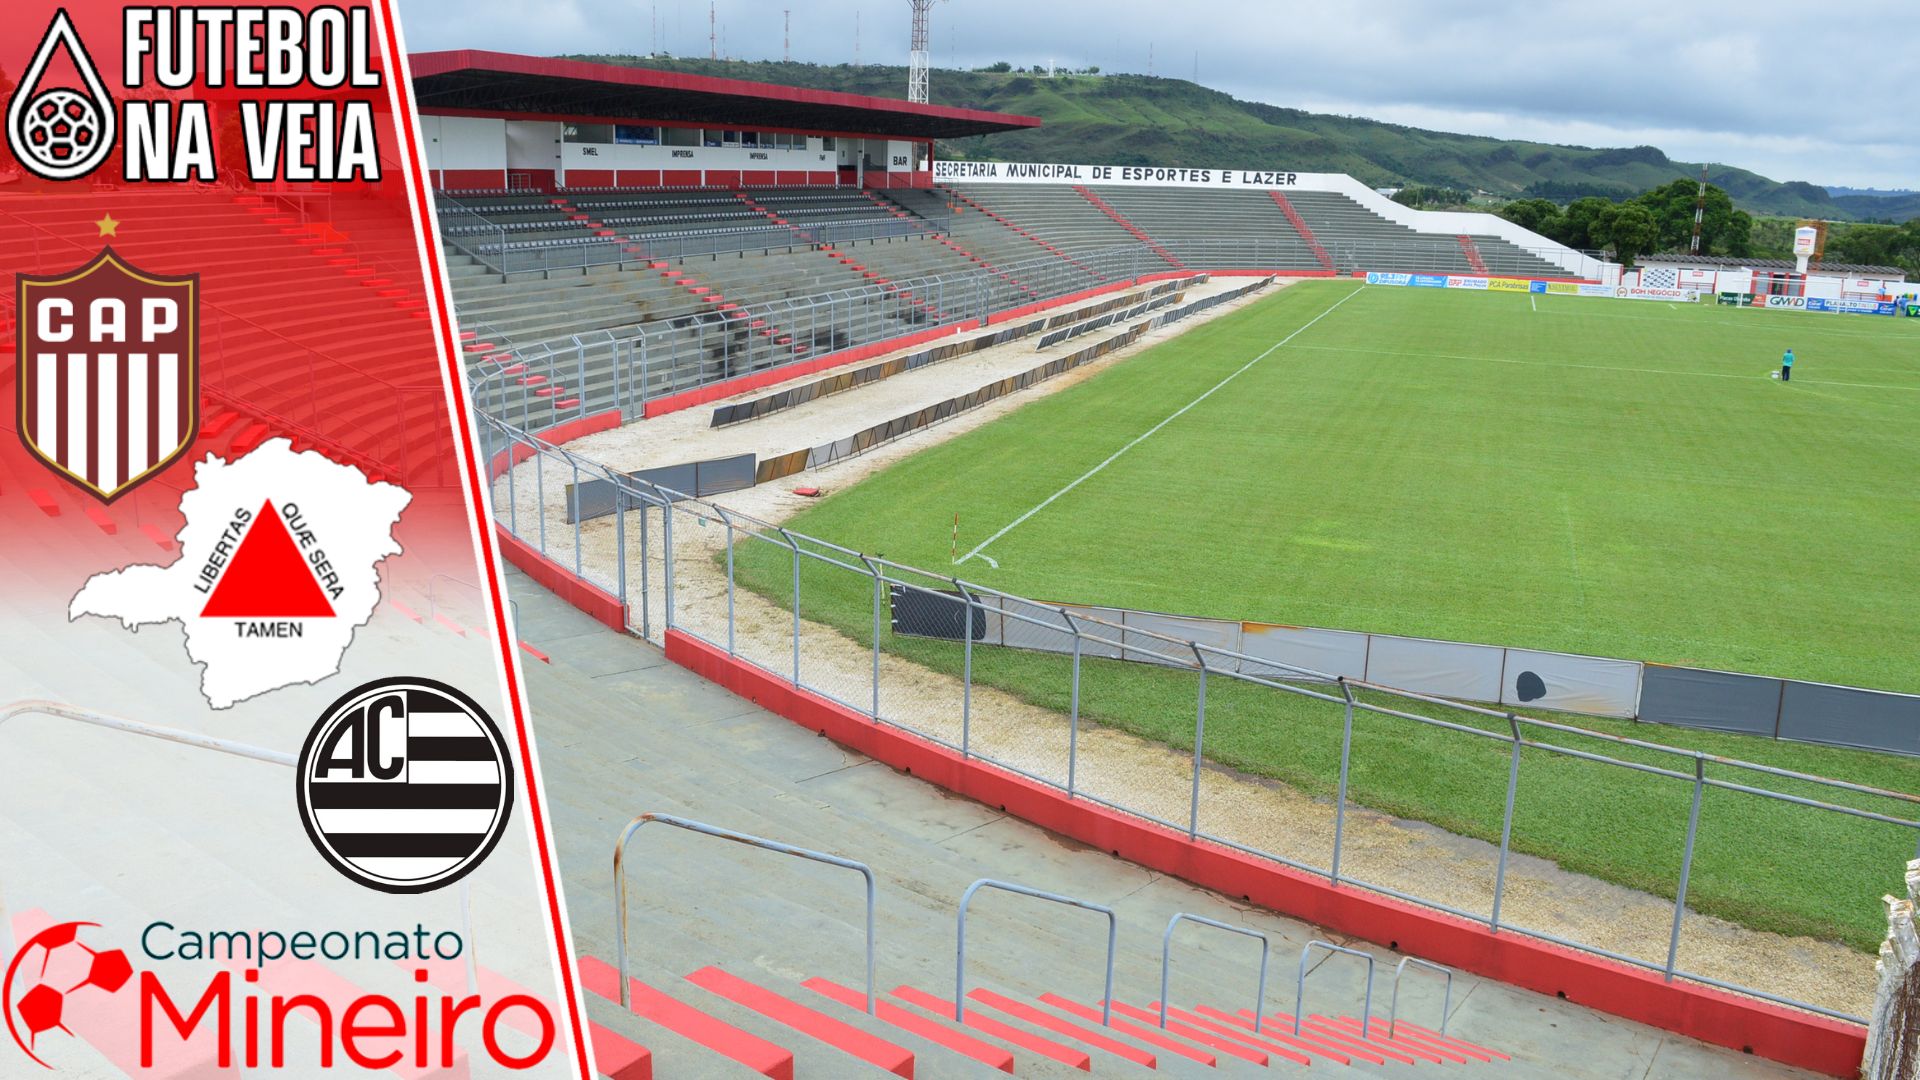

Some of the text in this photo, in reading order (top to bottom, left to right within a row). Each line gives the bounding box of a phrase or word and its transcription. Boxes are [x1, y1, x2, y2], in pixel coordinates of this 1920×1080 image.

[582, 147, 598, 156] SMEL
[672, 150, 694, 158] IMPRENSA
[893, 156, 907, 166] BAR
[935, 162, 1297, 186] SECRETARIA MUNICIPAL DE ESPORTES E LAZER
[1770, 296, 1805, 307] GMAD
